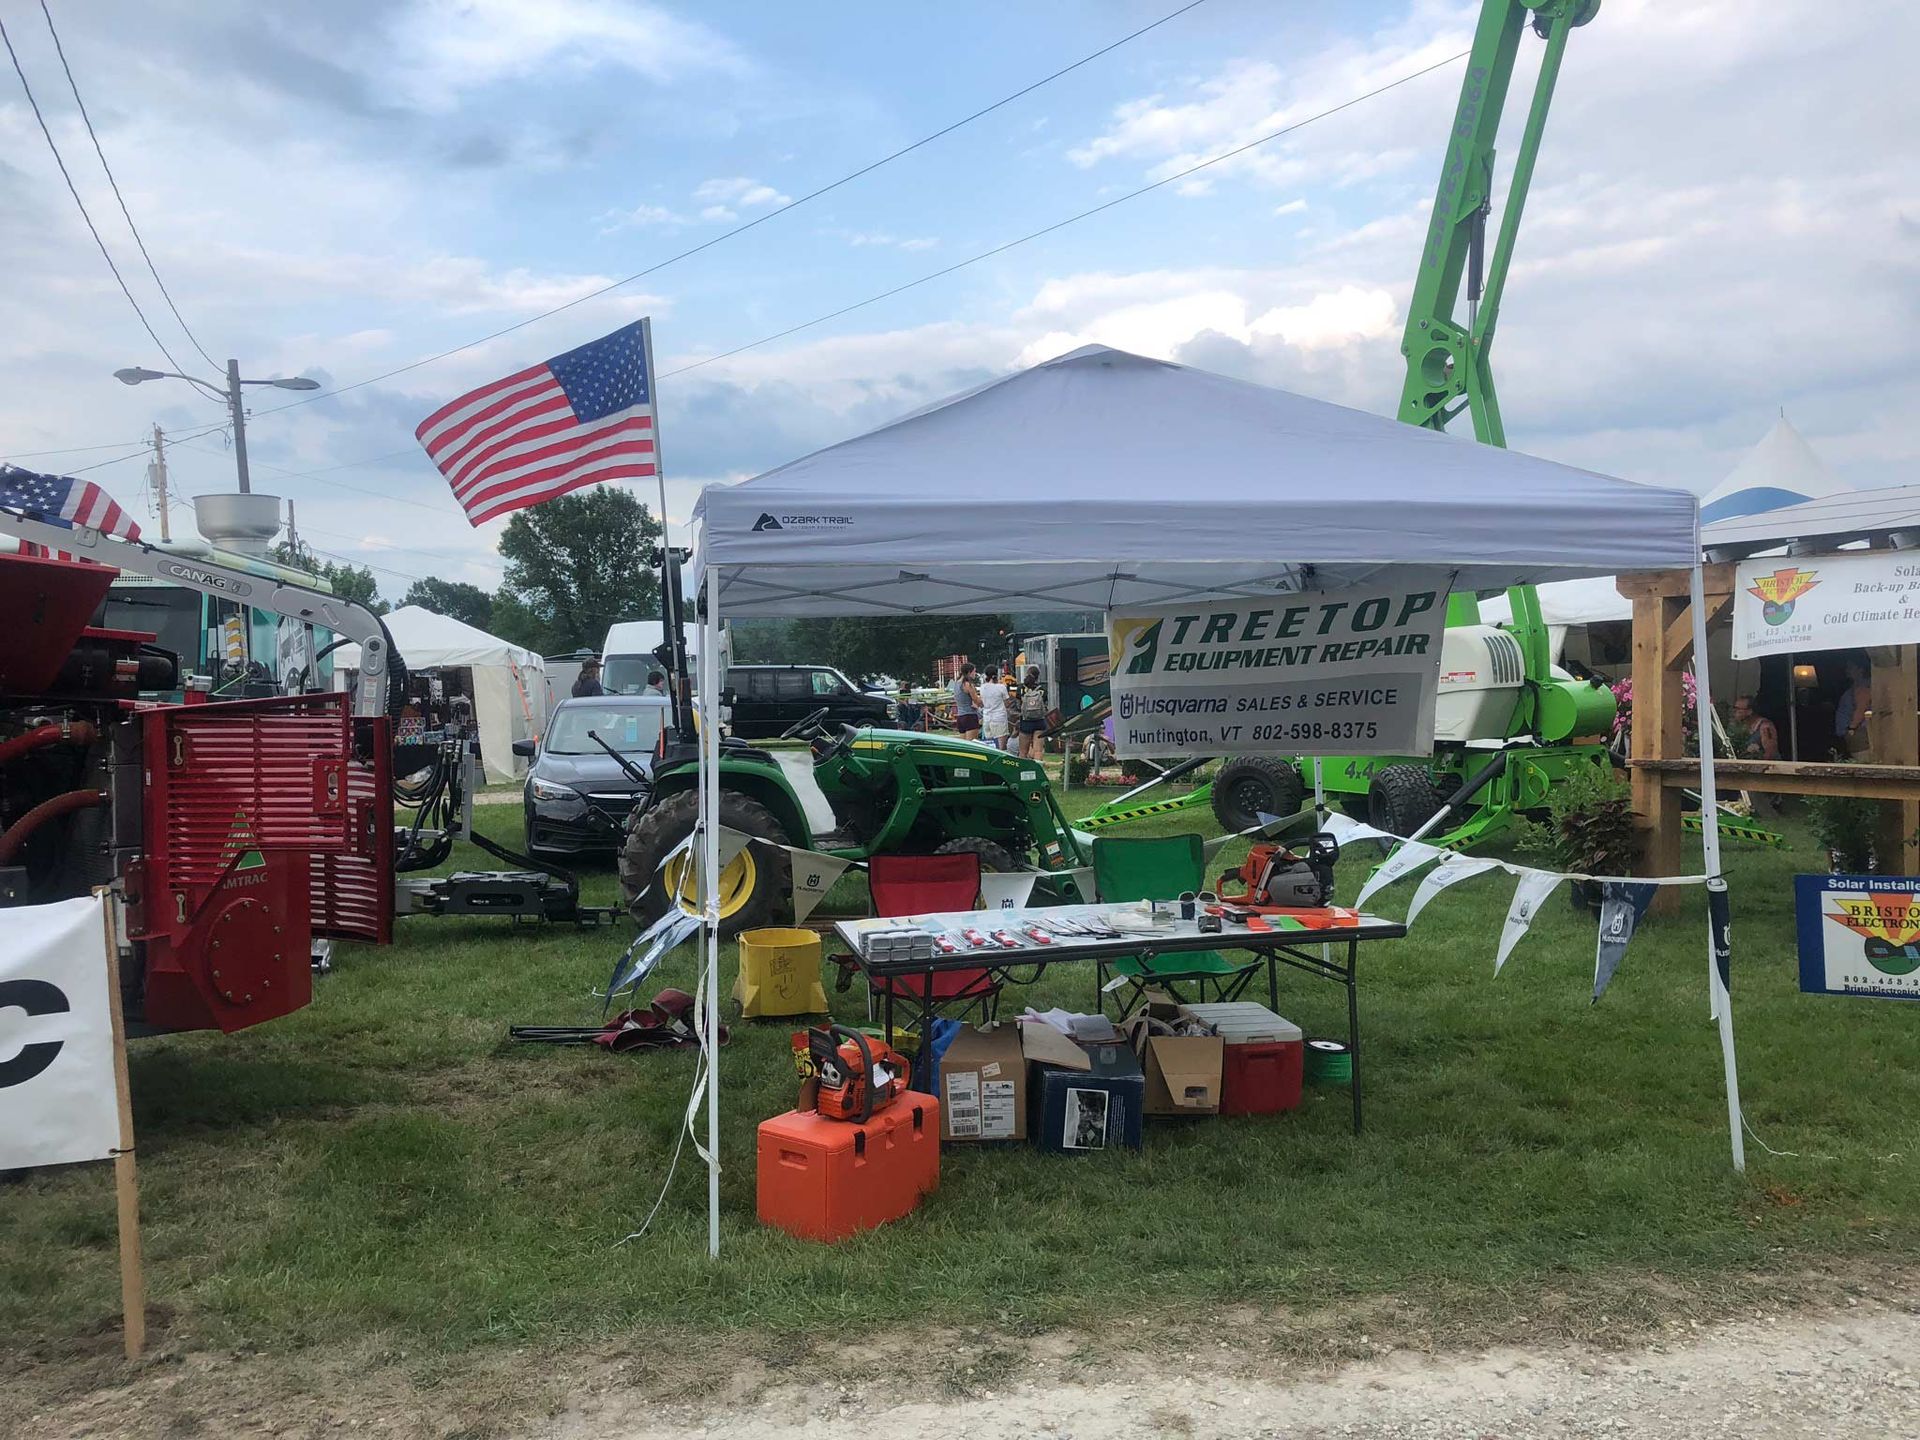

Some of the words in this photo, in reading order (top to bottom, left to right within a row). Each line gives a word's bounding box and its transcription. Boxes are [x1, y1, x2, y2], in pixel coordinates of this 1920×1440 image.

[169, 565, 227, 588] CANAG
[1854, 582, 1904, 593] Back-up
[1898, 594, 1909, 604] &
[1170, 591, 1437, 645] TREETOP
[1823, 611, 1849, 625] Cold
[1853, 609, 1899, 622] Climate
[1163, 645, 1318, 673] EQUIPMENT
[1319, 633, 1430, 663] REPAIR
[1135, 695, 1229, 716] Husqvarna
[1236, 695, 1292, 712] SALES
[1297, 694, 1308, 709] &
[1314, 689, 1398, 707] SERVICE
[1129, 728, 1213, 746] Huntington,
[1221, 726, 1242, 741] VT
[1252, 721, 1378, 740] 802-598-8375
[1828, 879, 1865, 889] Solar
[1844, 984, 1920, 996] BristolElectronics
